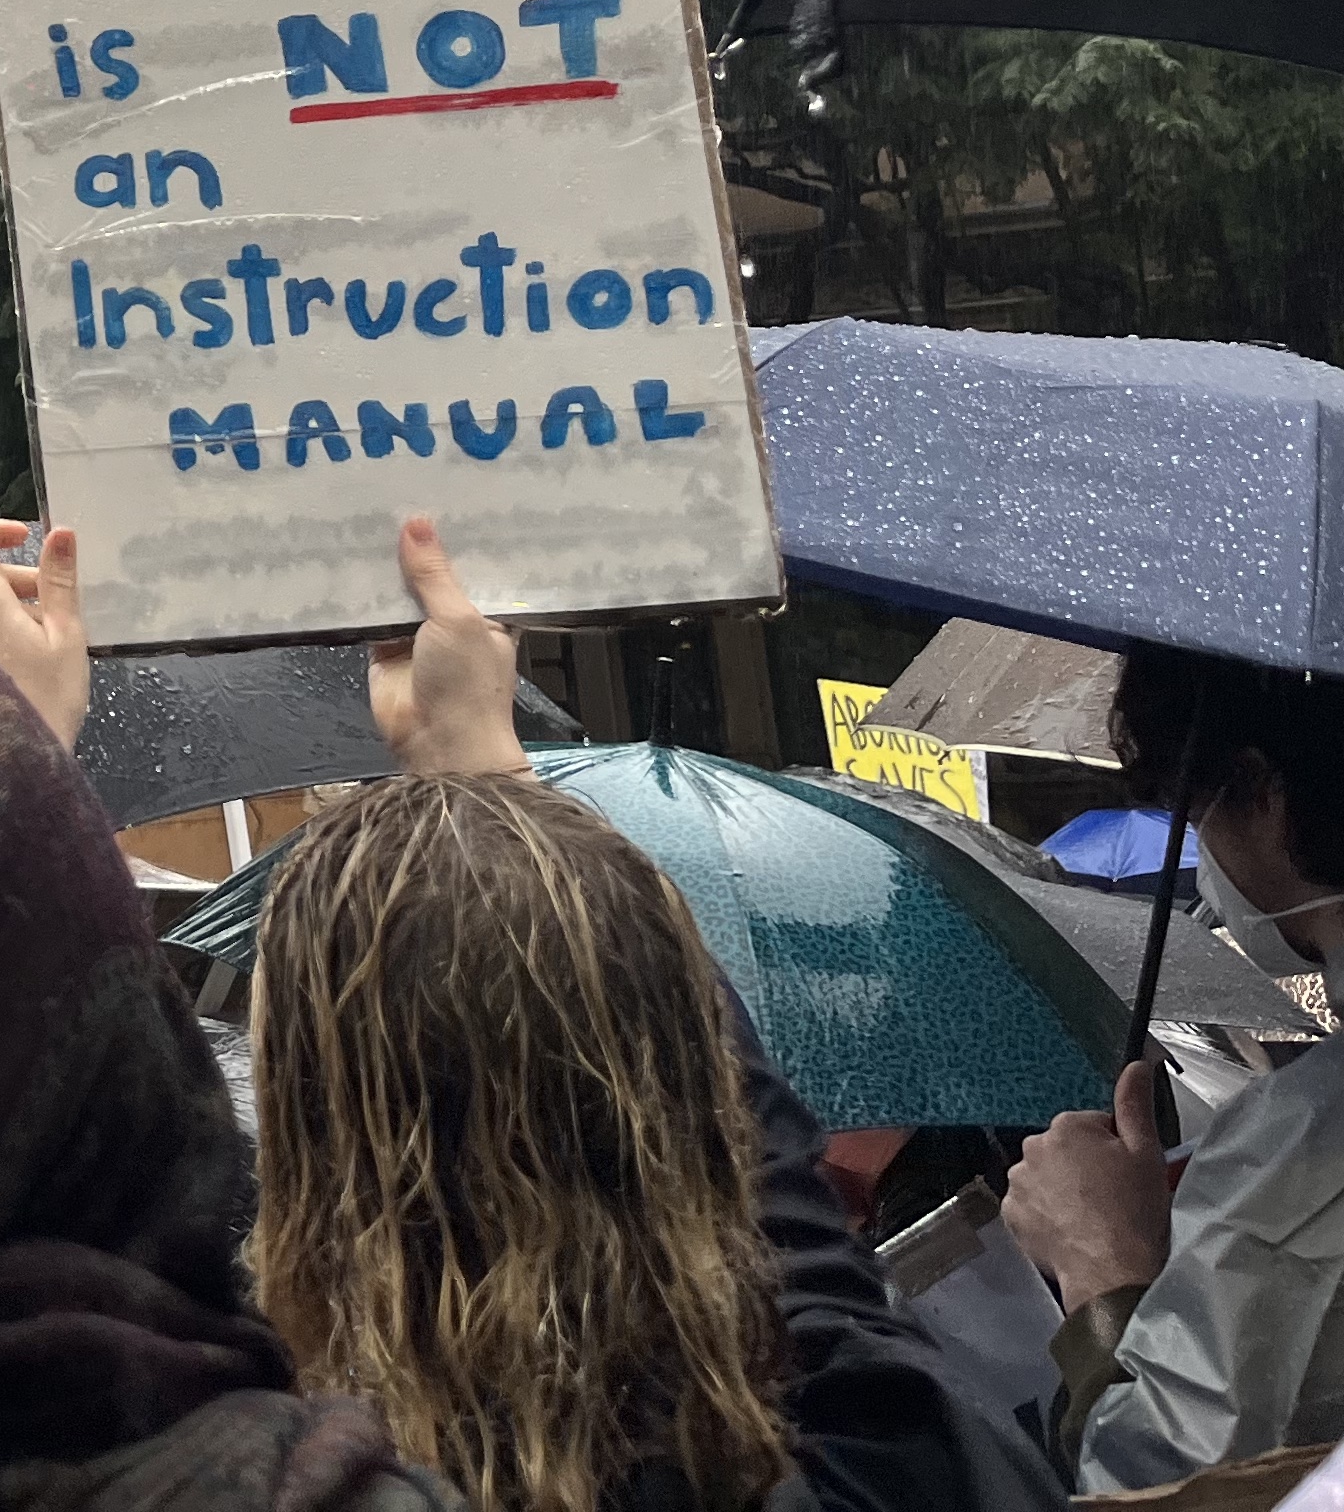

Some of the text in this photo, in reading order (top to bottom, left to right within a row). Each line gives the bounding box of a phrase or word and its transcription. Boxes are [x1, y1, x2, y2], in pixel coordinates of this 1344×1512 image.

[48, 22, 140, 100] is
[75, 148, 222, 210] an
[71, 233, 720, 348] Instruction
[169, 380, 705, 471] MANUAL
